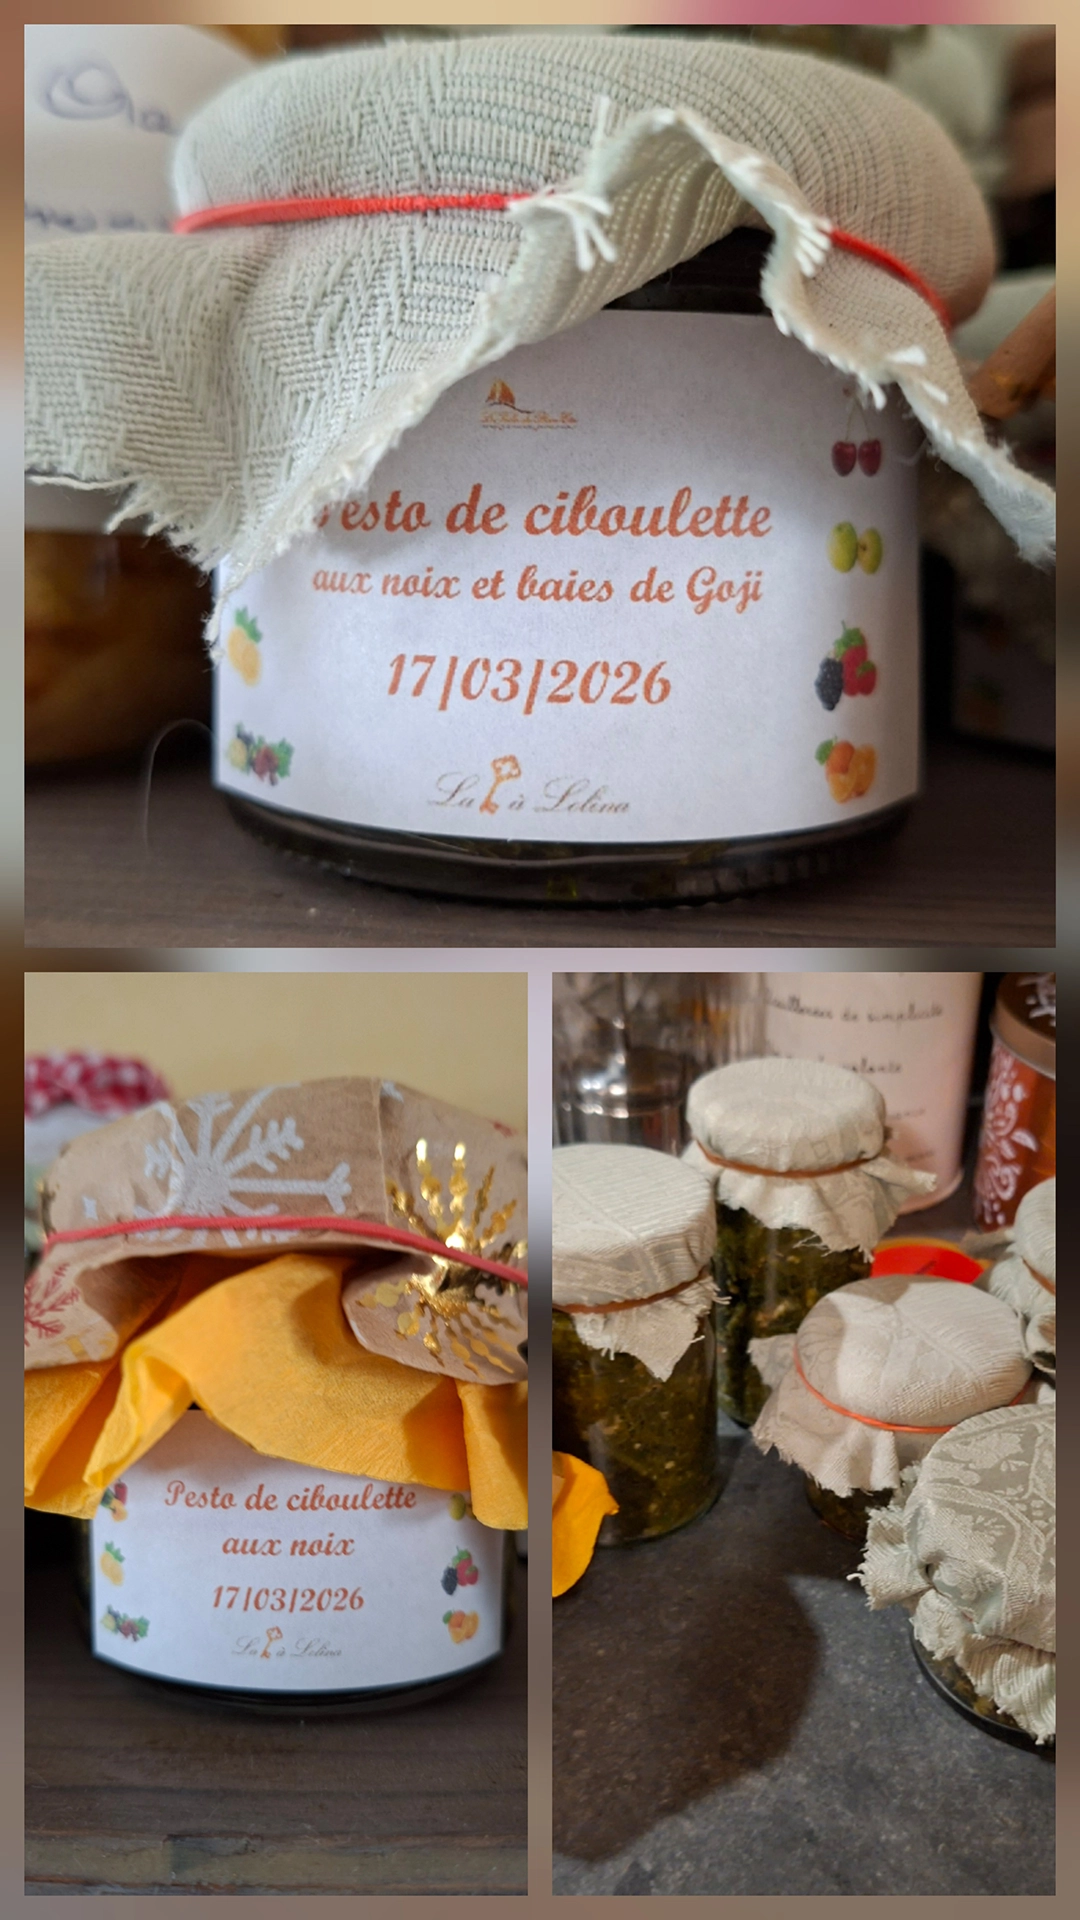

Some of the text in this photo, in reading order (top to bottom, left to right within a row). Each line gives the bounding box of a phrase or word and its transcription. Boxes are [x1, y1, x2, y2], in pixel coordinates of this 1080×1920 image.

[445, 483, 508, 535] de
[524, 485, 772, 537] ciboulette
[312, 564, 763, 615] aux noix et baies de Goji
[388, 653, 671, 715] 17/03/2026
[427, 771, 475, 810] La
[164, 1480, 417, 1511] Pesto de ciboulette
[221, 1532, 355, 1556] aux noix
[212, 1585, 364, 1613] 17/03/2026
